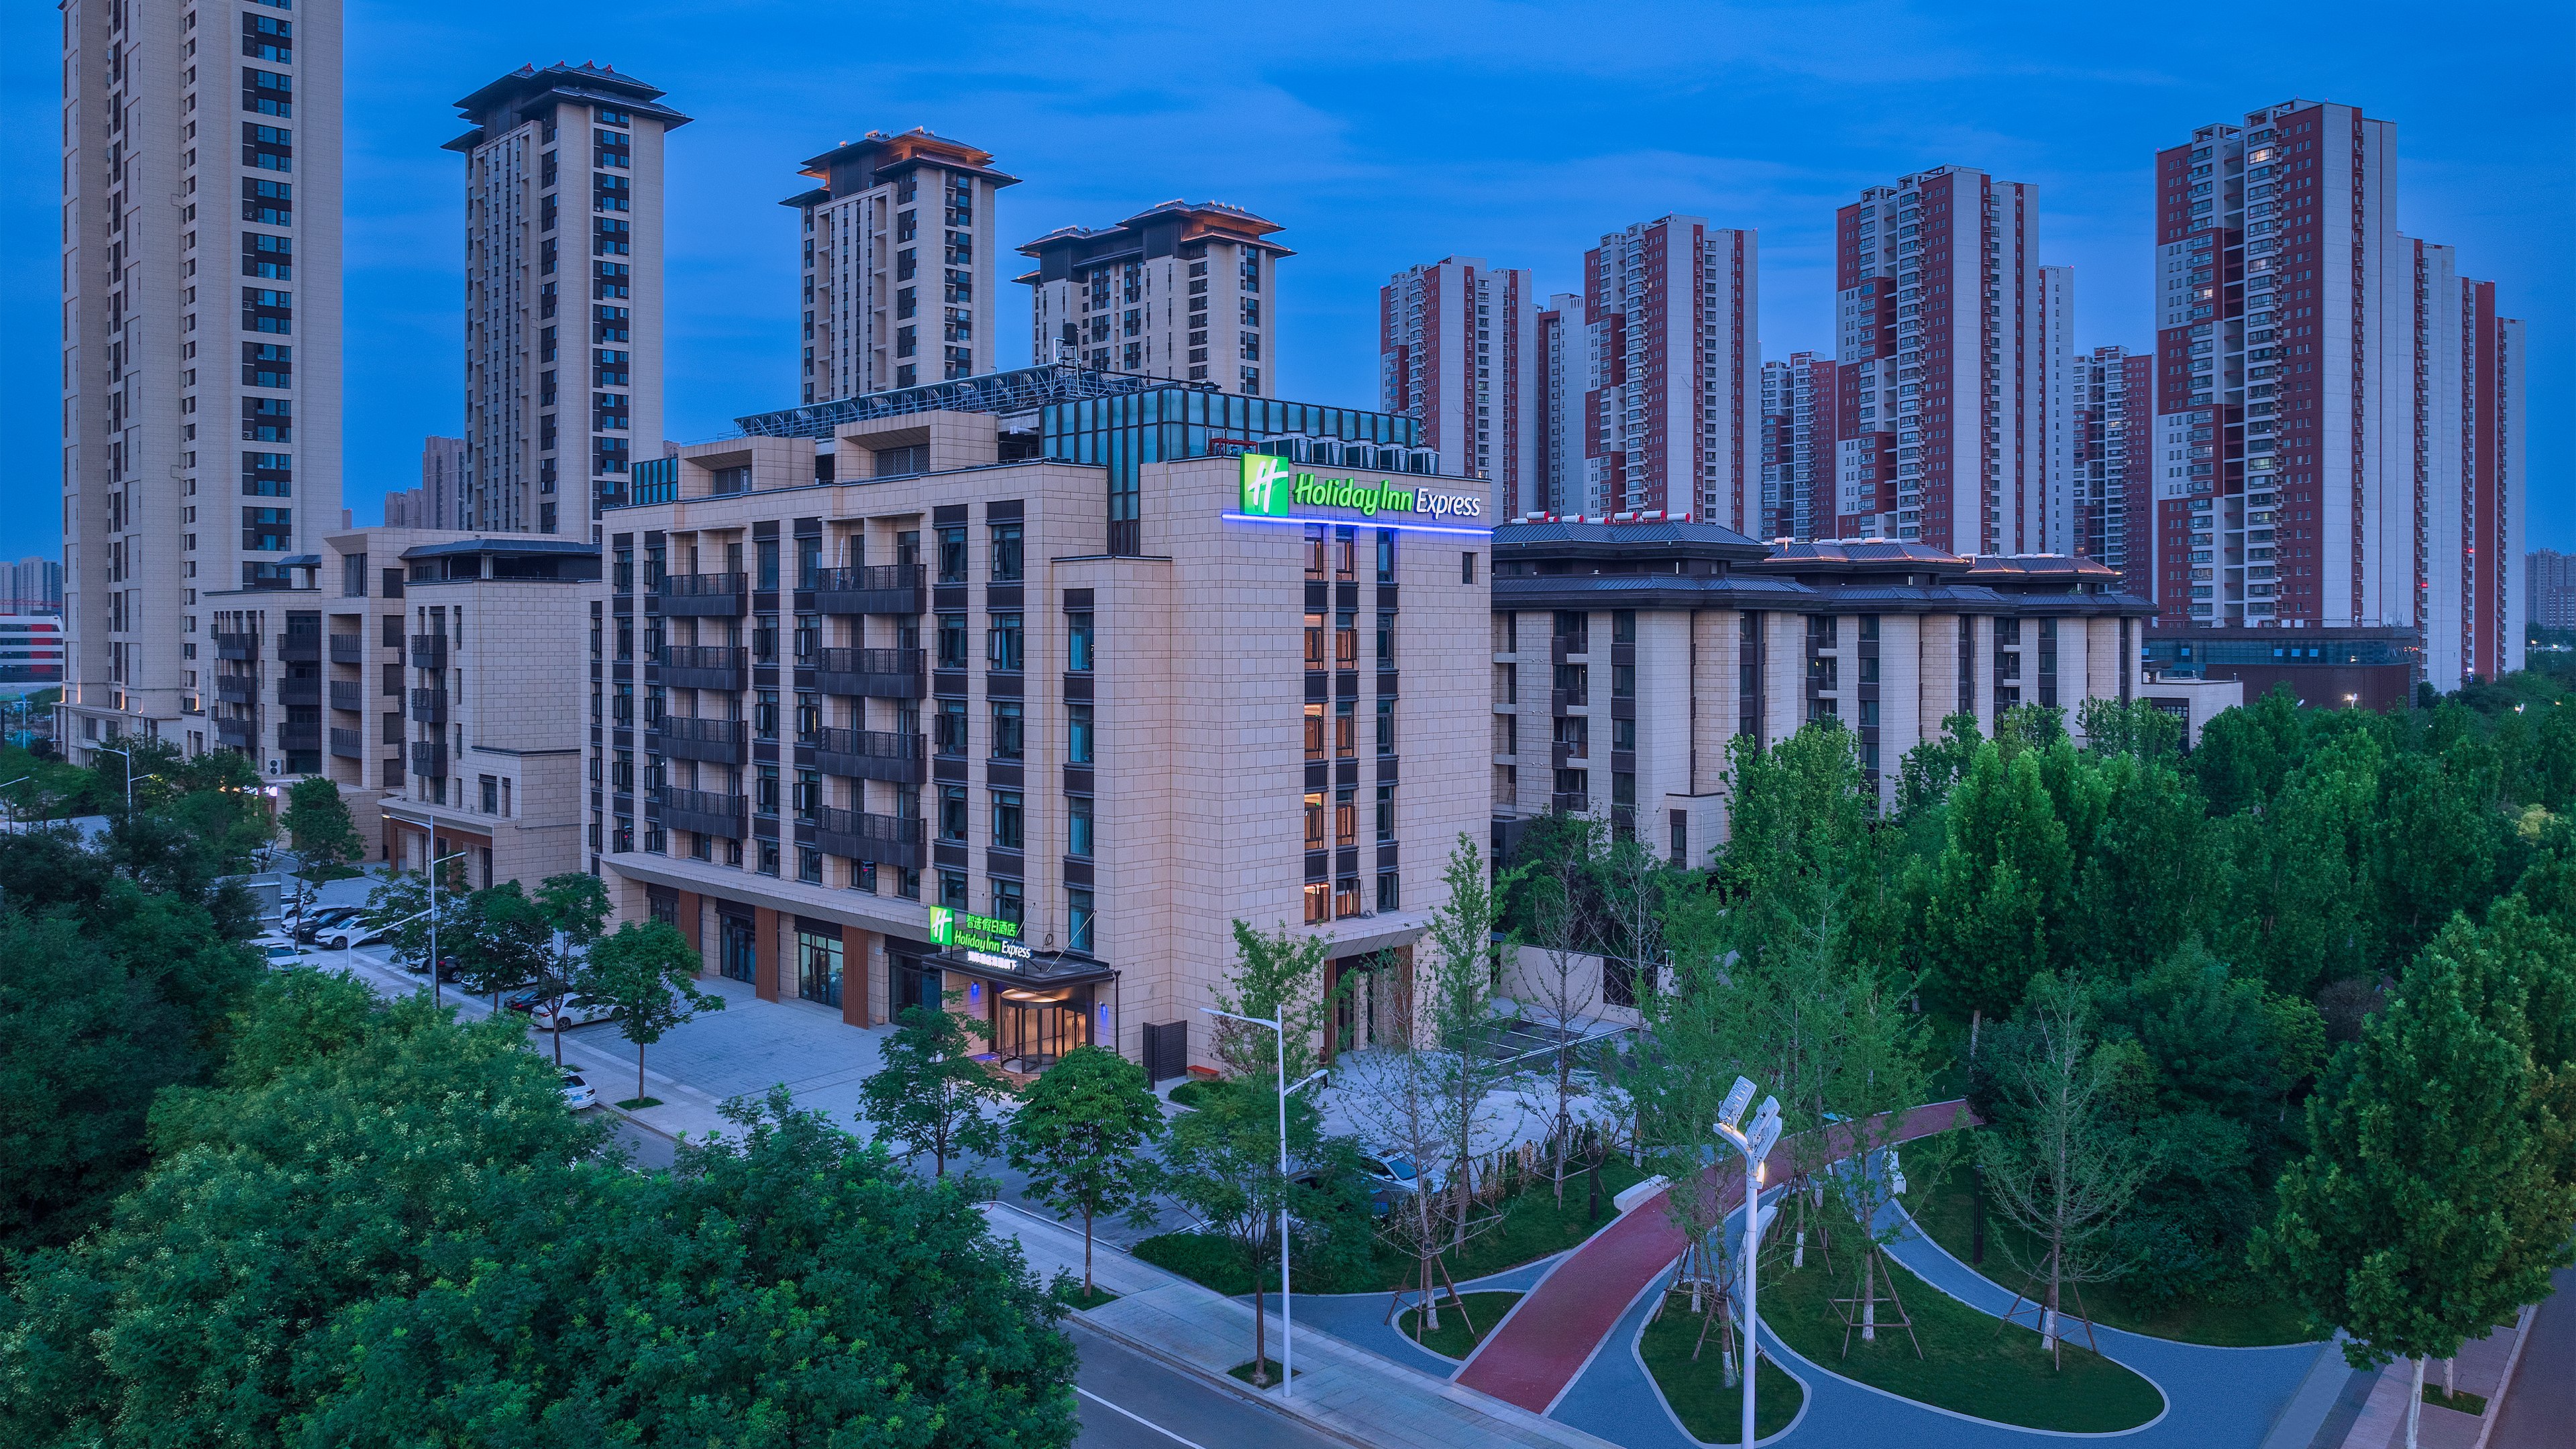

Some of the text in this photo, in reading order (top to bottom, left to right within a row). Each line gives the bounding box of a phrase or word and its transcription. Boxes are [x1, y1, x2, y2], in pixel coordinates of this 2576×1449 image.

[1293, 472, 1481, 520] Holiday Inn Express
[966, 914, 1018, 937] 智选假日酒店
[954, 929, 1031, 959] Holiday Inn Express
